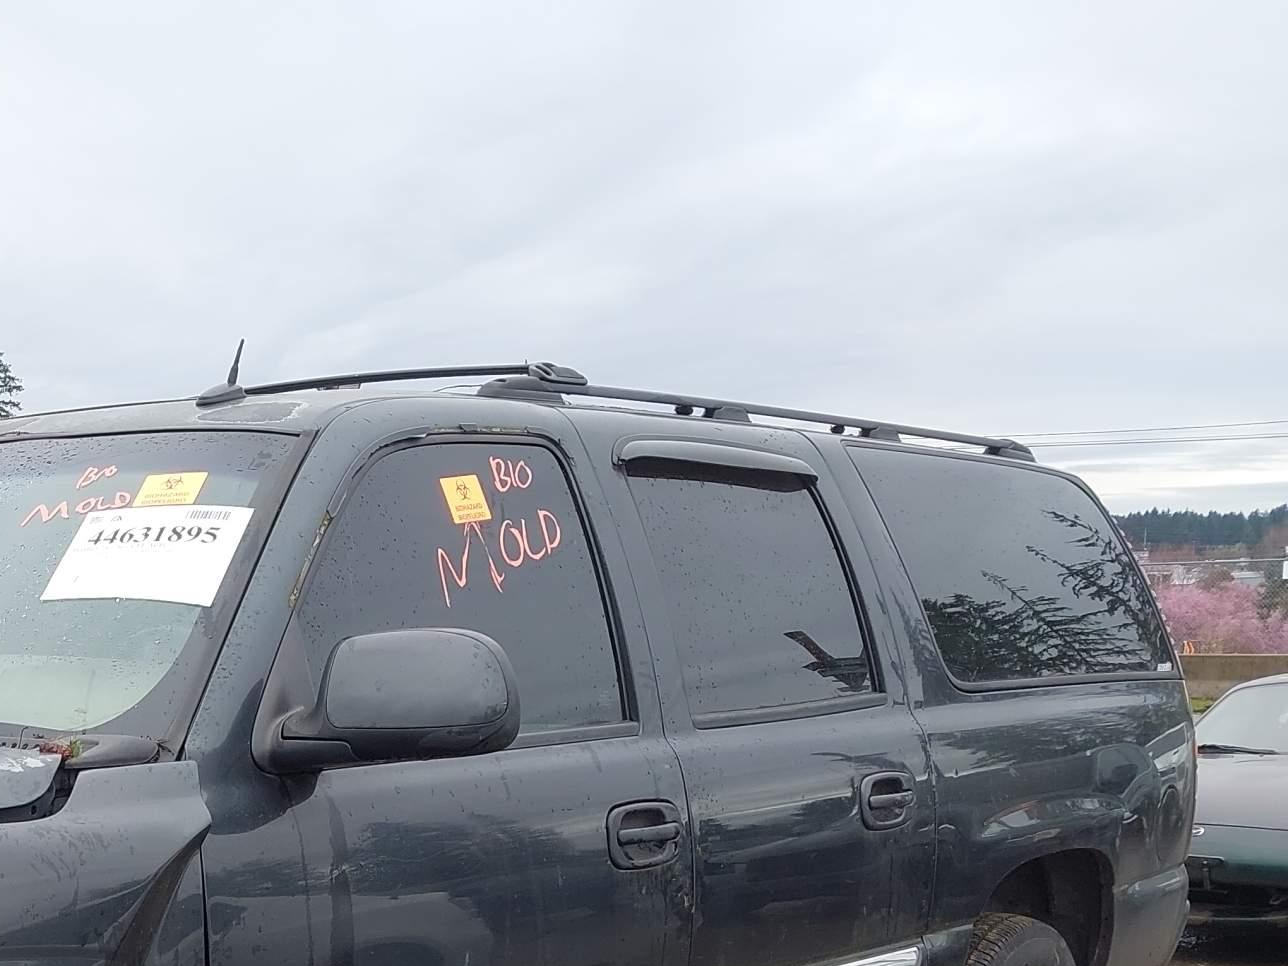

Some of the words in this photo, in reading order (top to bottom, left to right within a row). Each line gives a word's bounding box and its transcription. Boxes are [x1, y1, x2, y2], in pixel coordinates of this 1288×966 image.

[489, 456, 532, 492] BIO
[20, 491, 131, 527] MOLD
[88, 526, 221, 545] 44631895
[437, 509, 561, 608] MOLD
